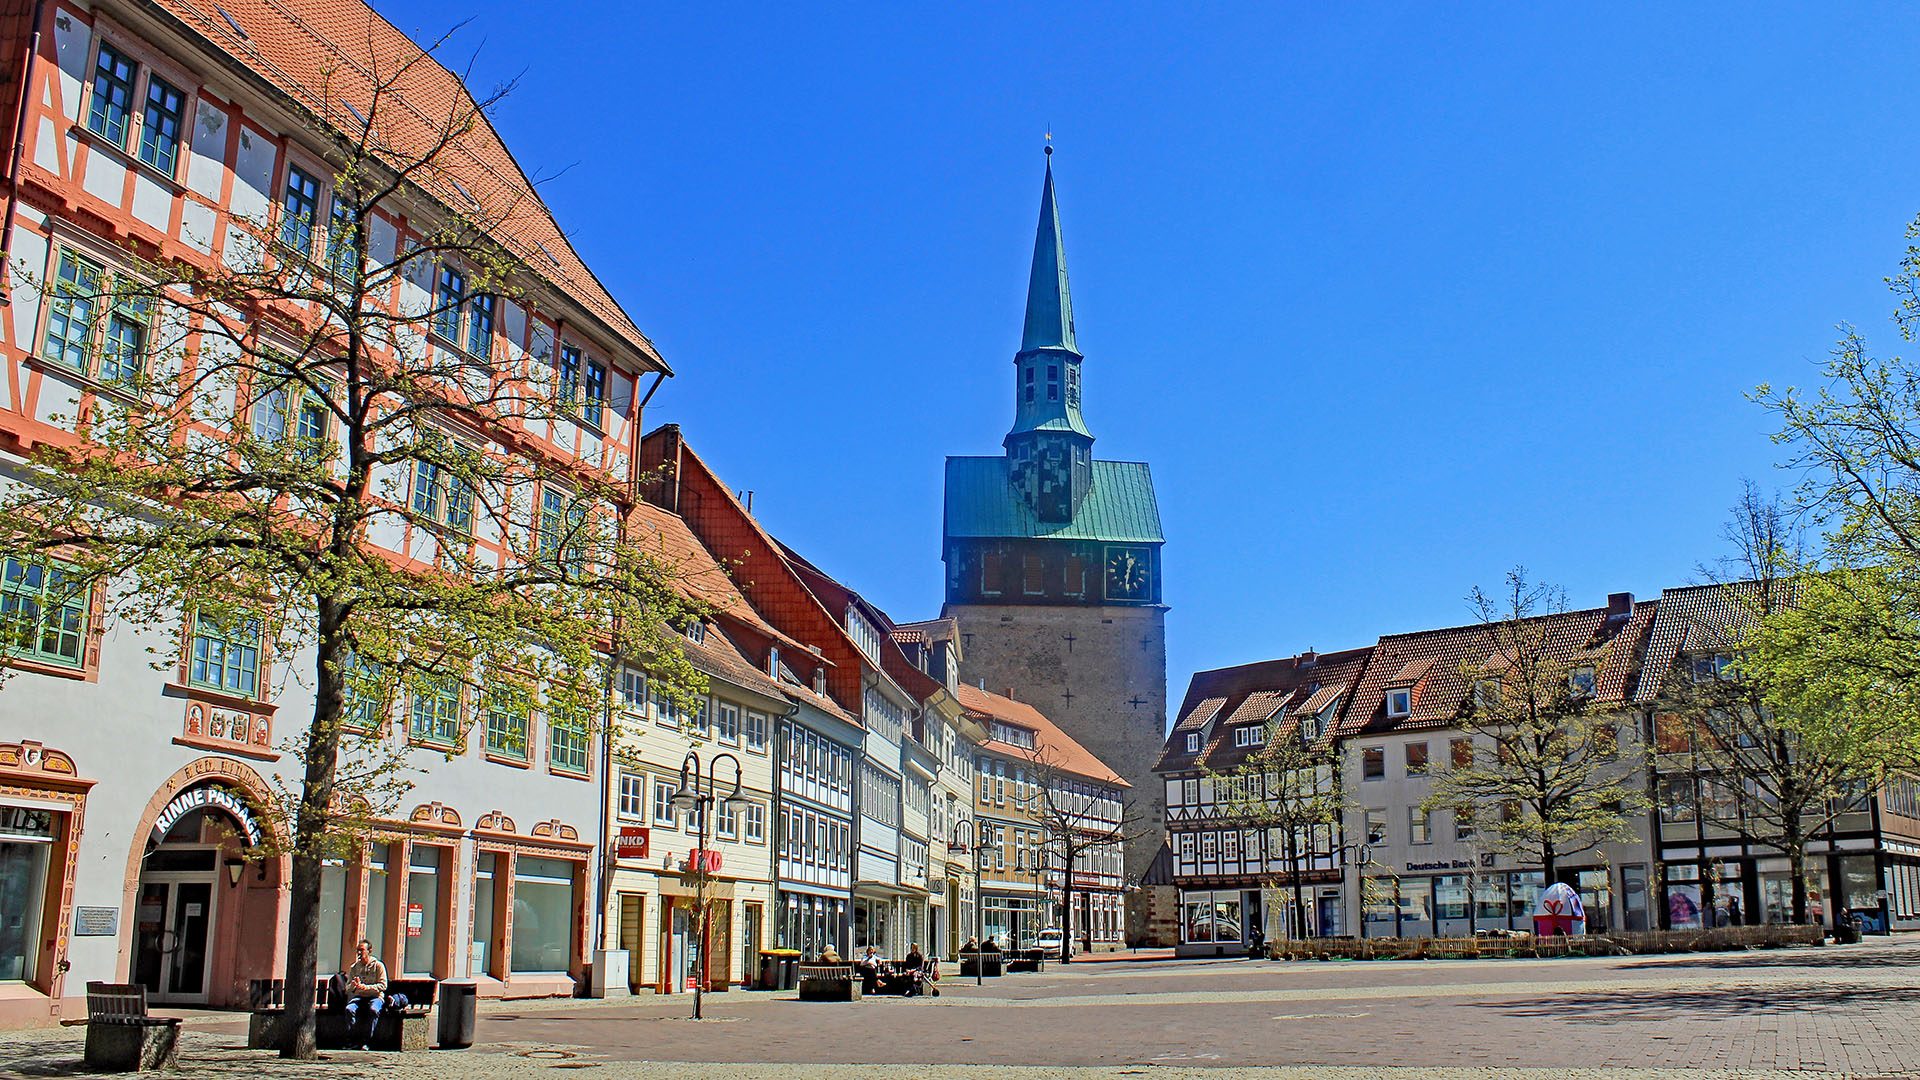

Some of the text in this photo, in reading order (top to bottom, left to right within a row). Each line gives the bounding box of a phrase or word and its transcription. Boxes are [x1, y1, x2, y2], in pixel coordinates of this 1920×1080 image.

[155, 788, 261, 847] RINNE PASSAGE
[619, 836, 645, 846] NKD
[1406, 859, 1476, 871] Deutsche Bank
